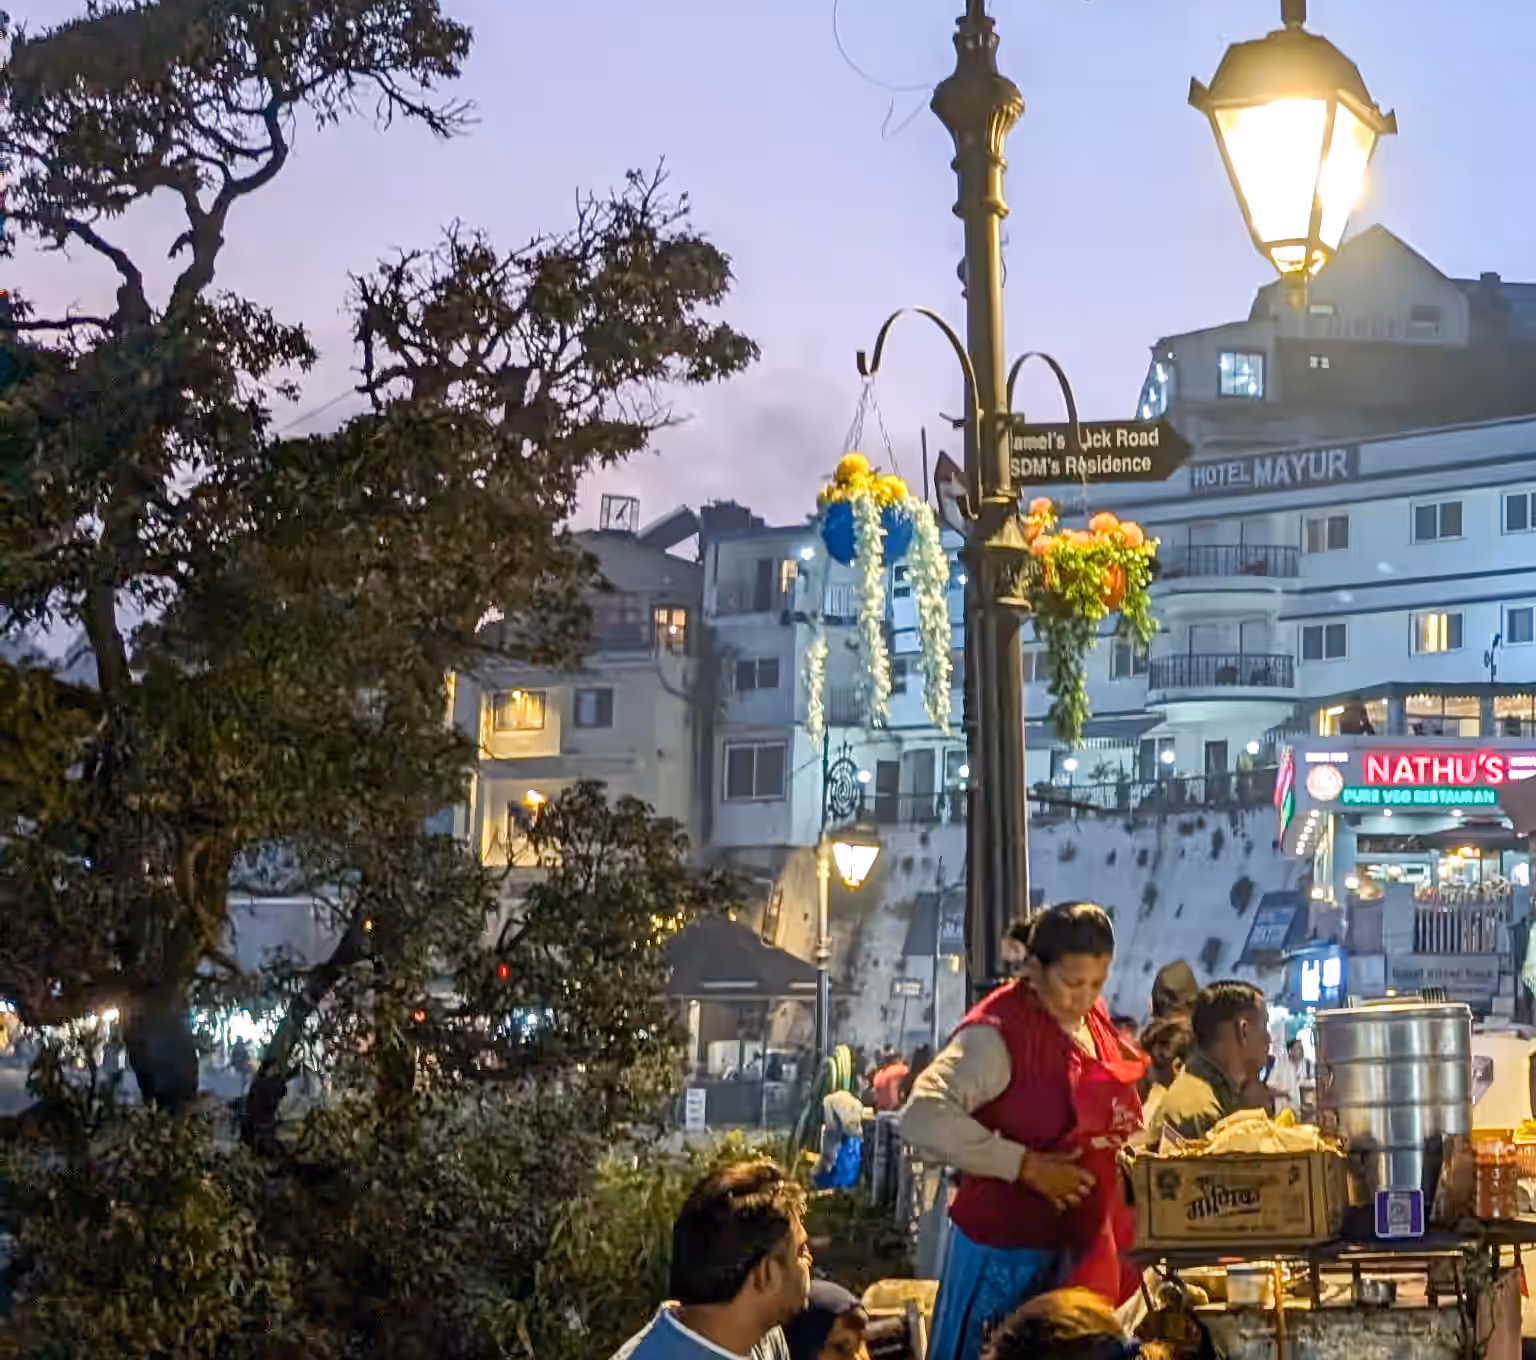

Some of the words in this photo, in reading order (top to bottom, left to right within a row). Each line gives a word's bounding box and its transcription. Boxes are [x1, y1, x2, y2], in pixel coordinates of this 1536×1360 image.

[1013, 431, 1066, 451] amel's
[1116, 426, 1160, 448] Road
[1010, 456, 1061, 478] SDM's
[1065, 454, 1152, 476] Residence
[1194, 462, 1249, 487] HOTEL
[1253, 449, 1349, 489] MAYUR
[1366, 754, 1505, 785] NATHU'S
[1343, 788, 1380, 804] PURE
[1382, 788, 1412, 804] VEG
